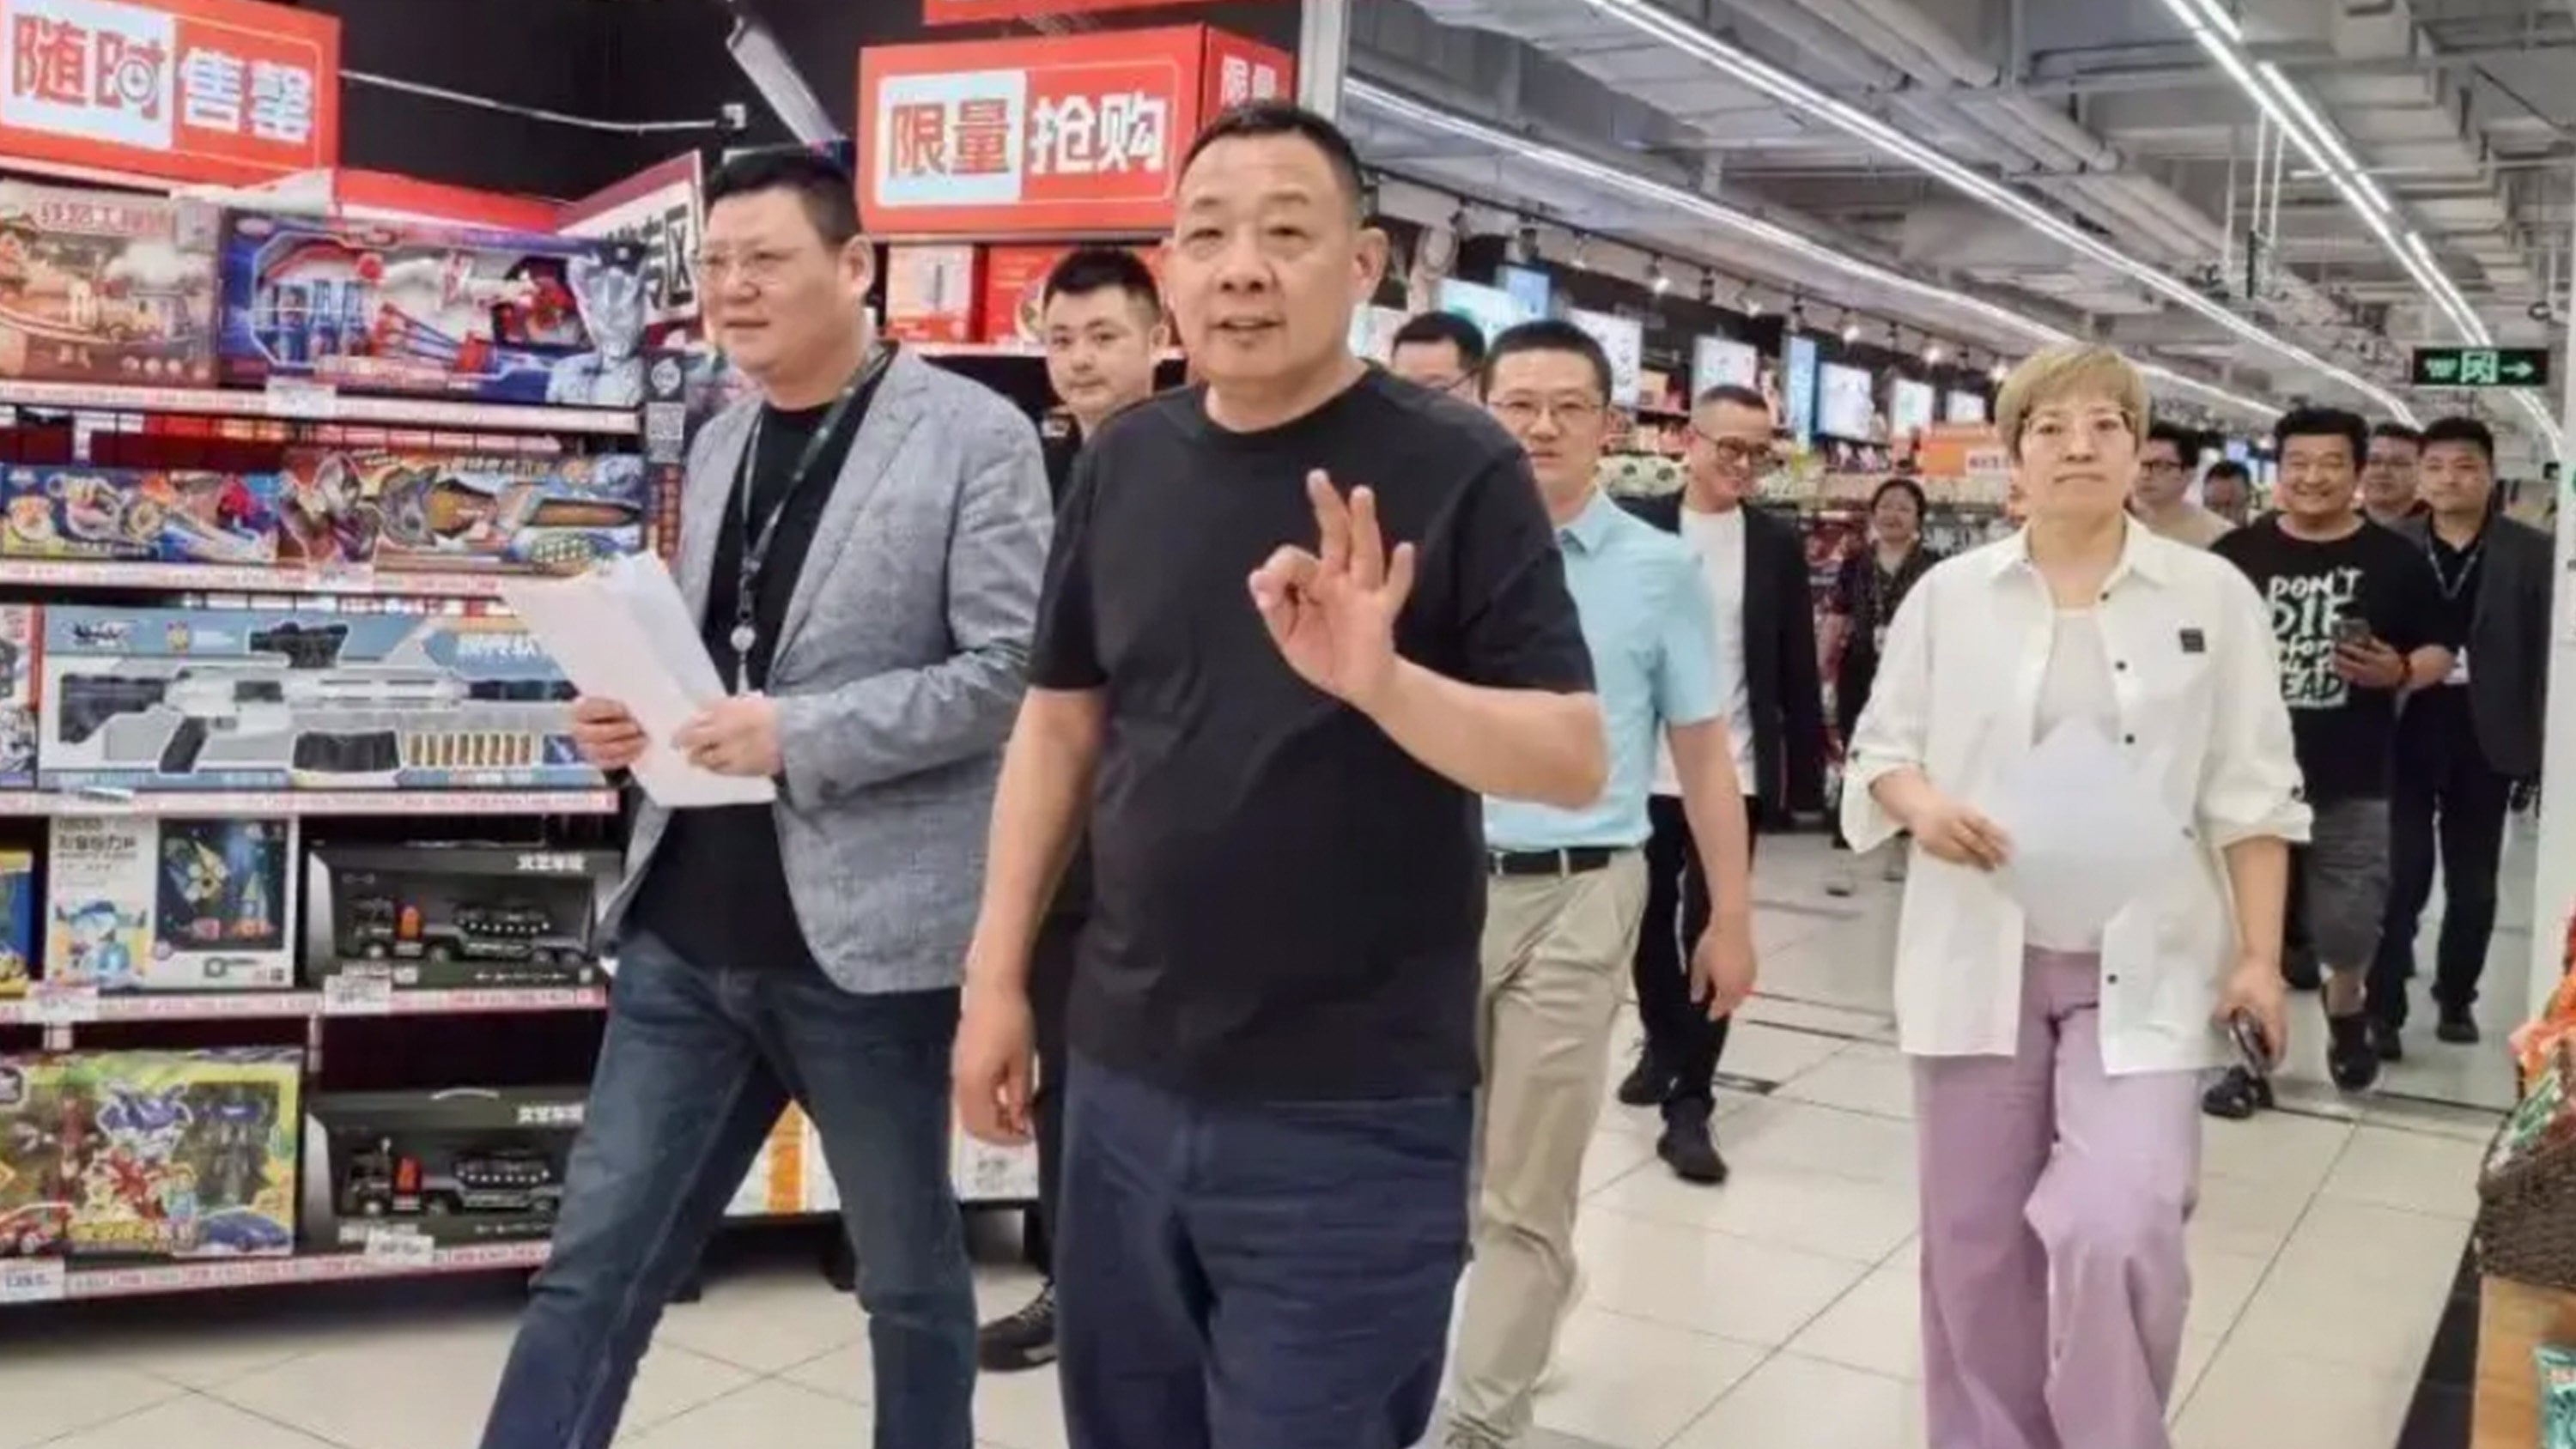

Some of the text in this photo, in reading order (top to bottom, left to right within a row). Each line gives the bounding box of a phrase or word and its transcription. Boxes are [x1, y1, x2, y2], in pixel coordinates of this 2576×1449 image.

[12, 14, 313, 144] 随时售罄
[891, 92, 1165, 177] 限量抢购
[2269, 566, 2363, 600] DON'T
[2280, 671, 2344, 702] EAD
